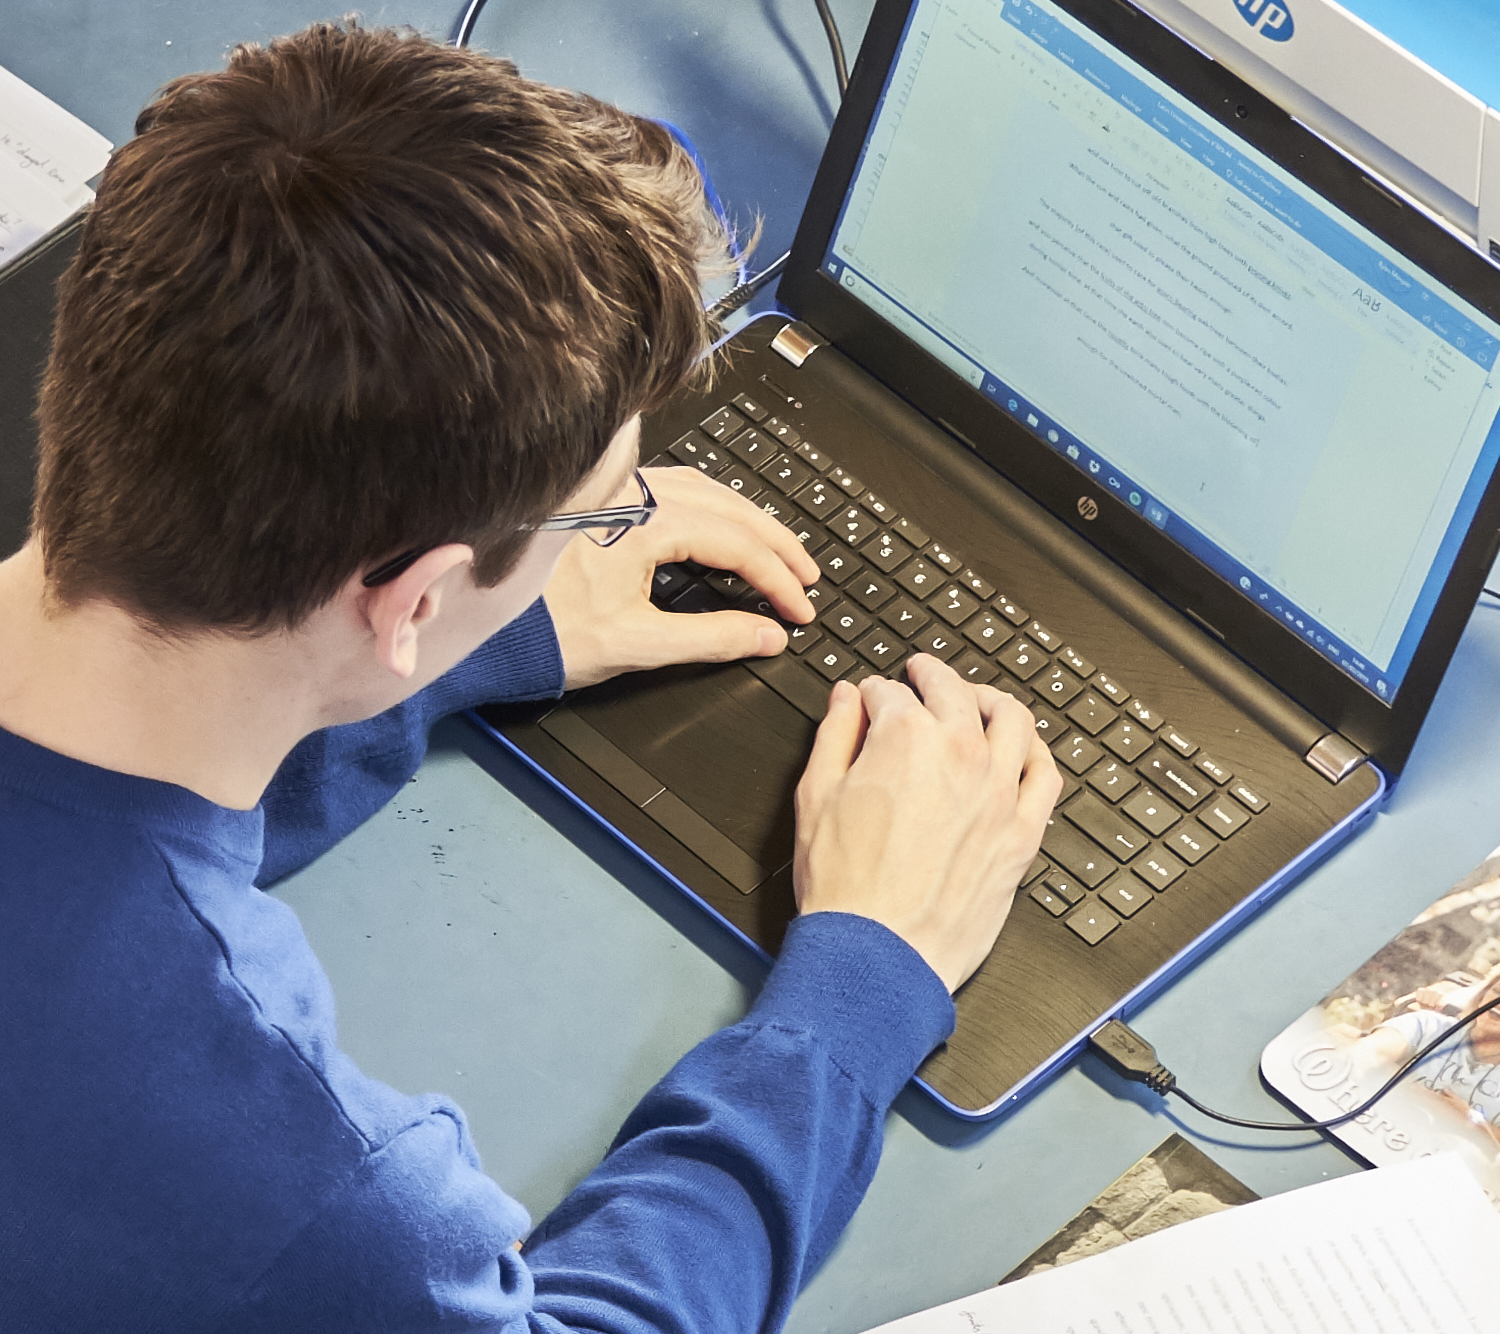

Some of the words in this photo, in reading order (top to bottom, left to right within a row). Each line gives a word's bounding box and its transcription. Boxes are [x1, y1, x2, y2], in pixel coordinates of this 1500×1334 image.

[779, 469, 791, 478] 2
[729, 478, 743, 491] Q
[813, 495, 825, 504] 3
[763, 503, 779, 517] W
[797, 531, 811, 543] E
[880, 548, 893, 557] 5
[829, 558, 843, 569] R
[915, 574, 926, 583] 6
[806, 588, 821, 599] F
[866, 584, 877, 594] T
[949, 600, 960, 608] 7
[901, 611, 912, 620] Y
[841, 617, 853, 627] G
[792, 628, 805, 638] V
[983, 628, 994, 637] 8
[874, 643, 889, 654] H
[933, 638, 947, 649] U
[824, 655, 837, 665] B
[1017, 655, 1028, 664] 9
[1052, 682, 1063, 691] 0
[1036, 719, 1049, 729] P
